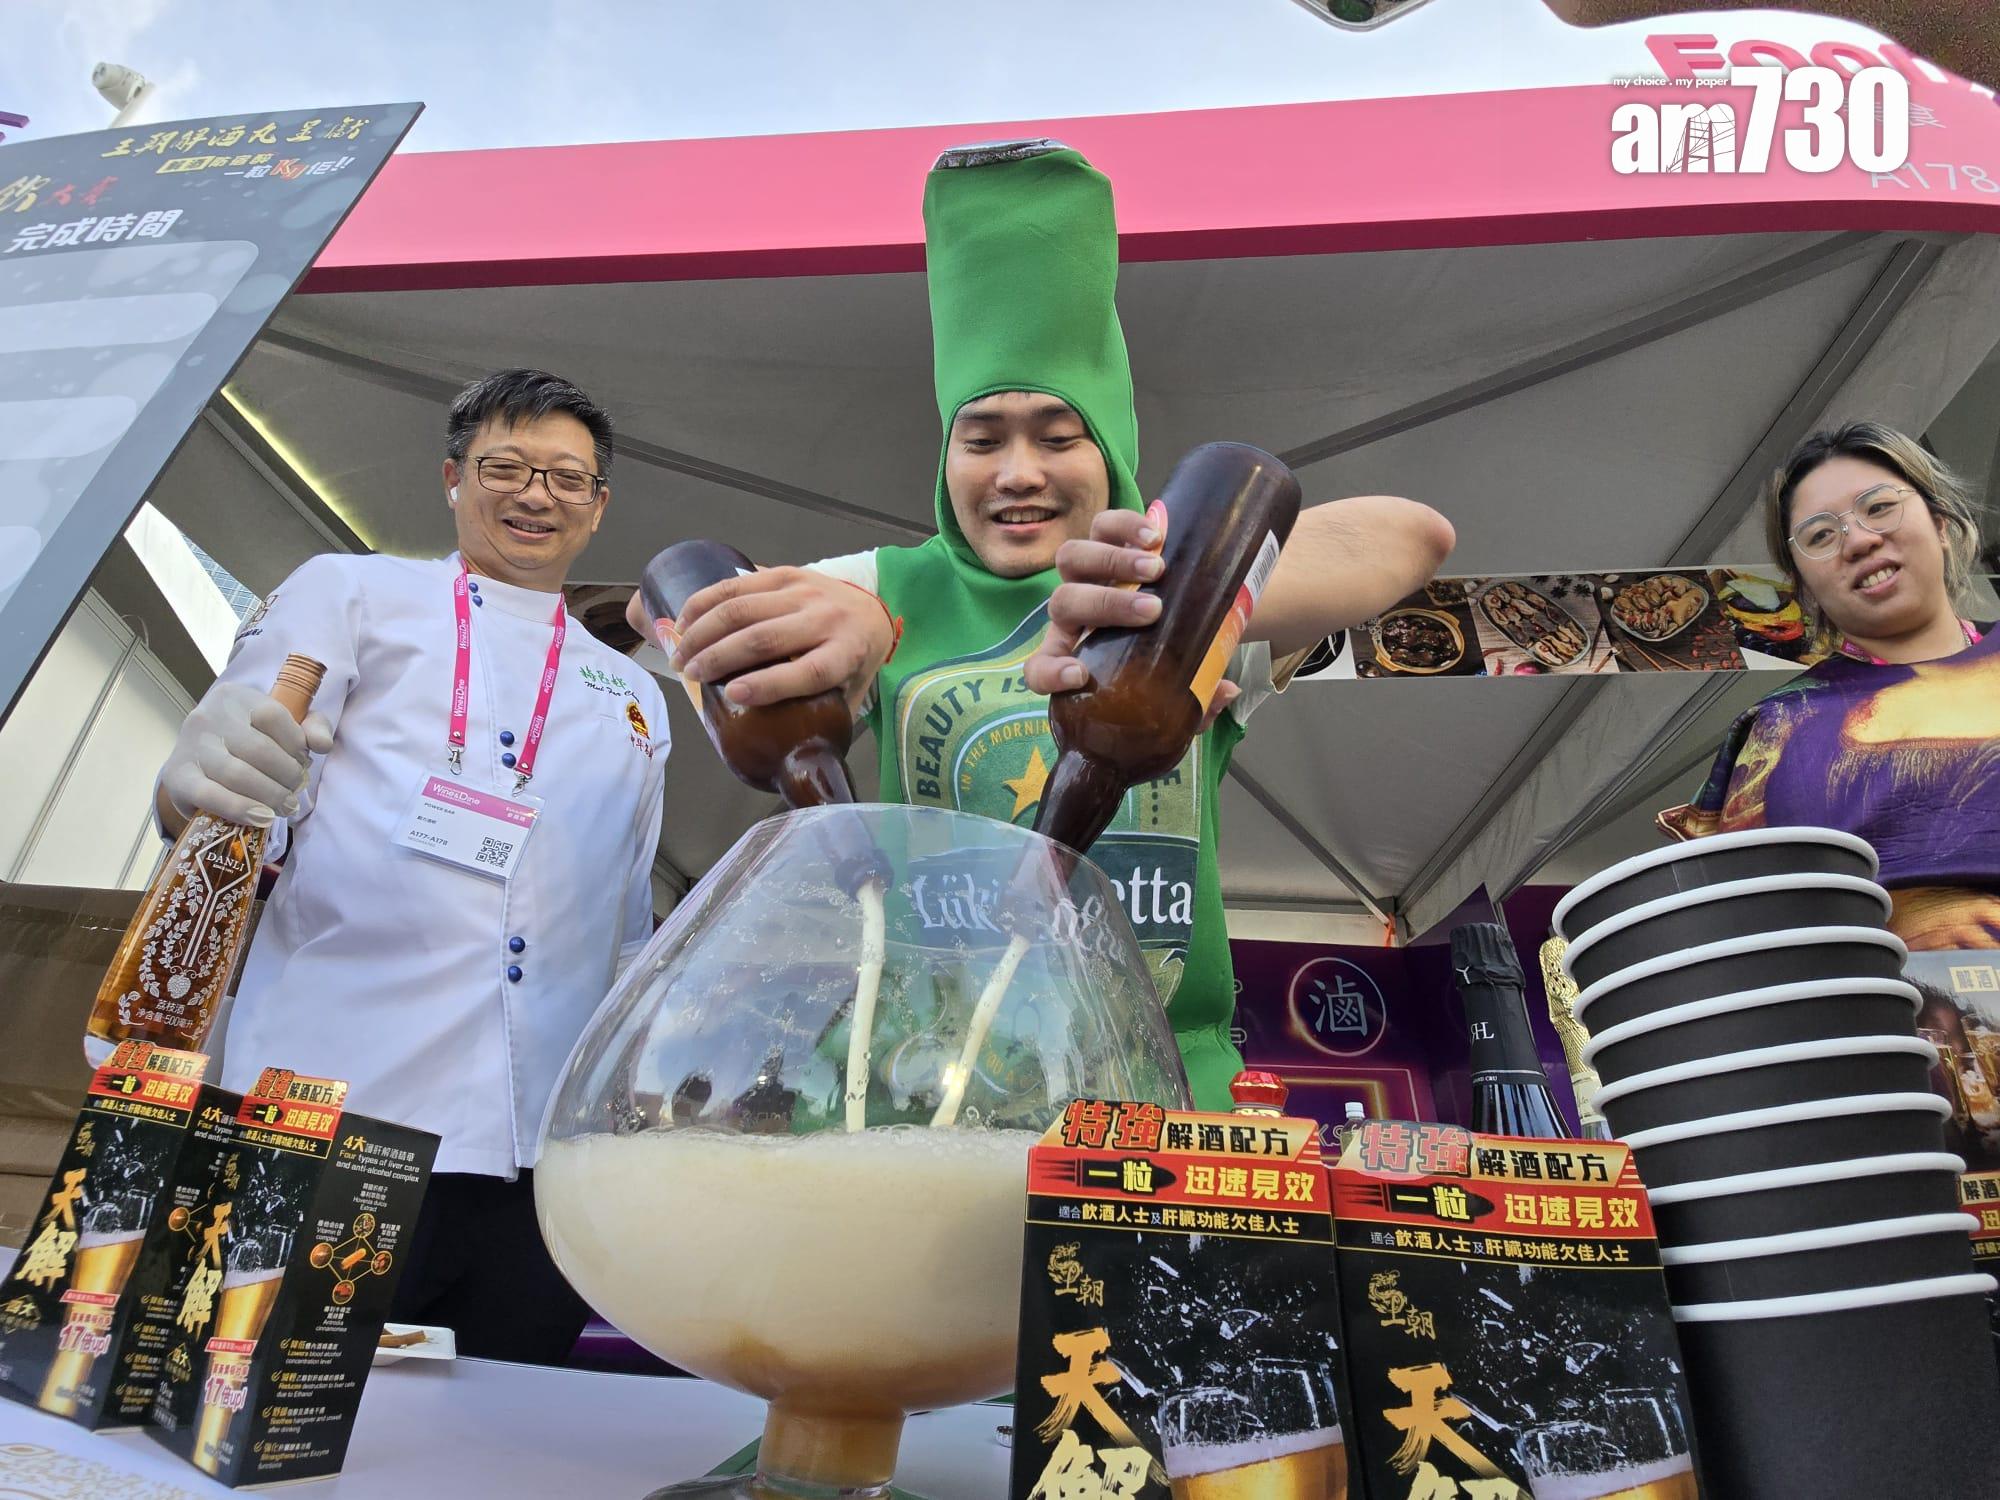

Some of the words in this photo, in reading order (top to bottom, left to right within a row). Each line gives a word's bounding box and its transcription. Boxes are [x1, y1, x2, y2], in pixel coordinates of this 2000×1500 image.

[3, 209, 184, 253] 完成時間
[916, 678, 985, 800] BEAUTY
[965, 738, 988, 768] THE
[990, 719, 1051, 746] MORNIN
[206, 851, 245, 872] DANLI
[1308, 975, 1369, 1037] 滷
[283, 1108, 335, 1133] 迅速見效
[336, 1160, 351, 1169] and
[351, 1163, 393, 1178] anti-alcohol
[392, 1172, 420, 1183] complex
[339, 1149, 357, 1160] Four
[358, 1153, 379, 1165] types
[379, 1159, 388, 1167] of
[388, 1160, 403, 1169] liver
[404, 1164, 420, 1173] care
[1088, 1160, 1153, 1194] 一粒
[1184, 1164, 1315, 1203] 迅速見效
[1396, 1186, 1471, 1221] 一粒
[1504, 1193, 1640, 1229] 迅速見效
